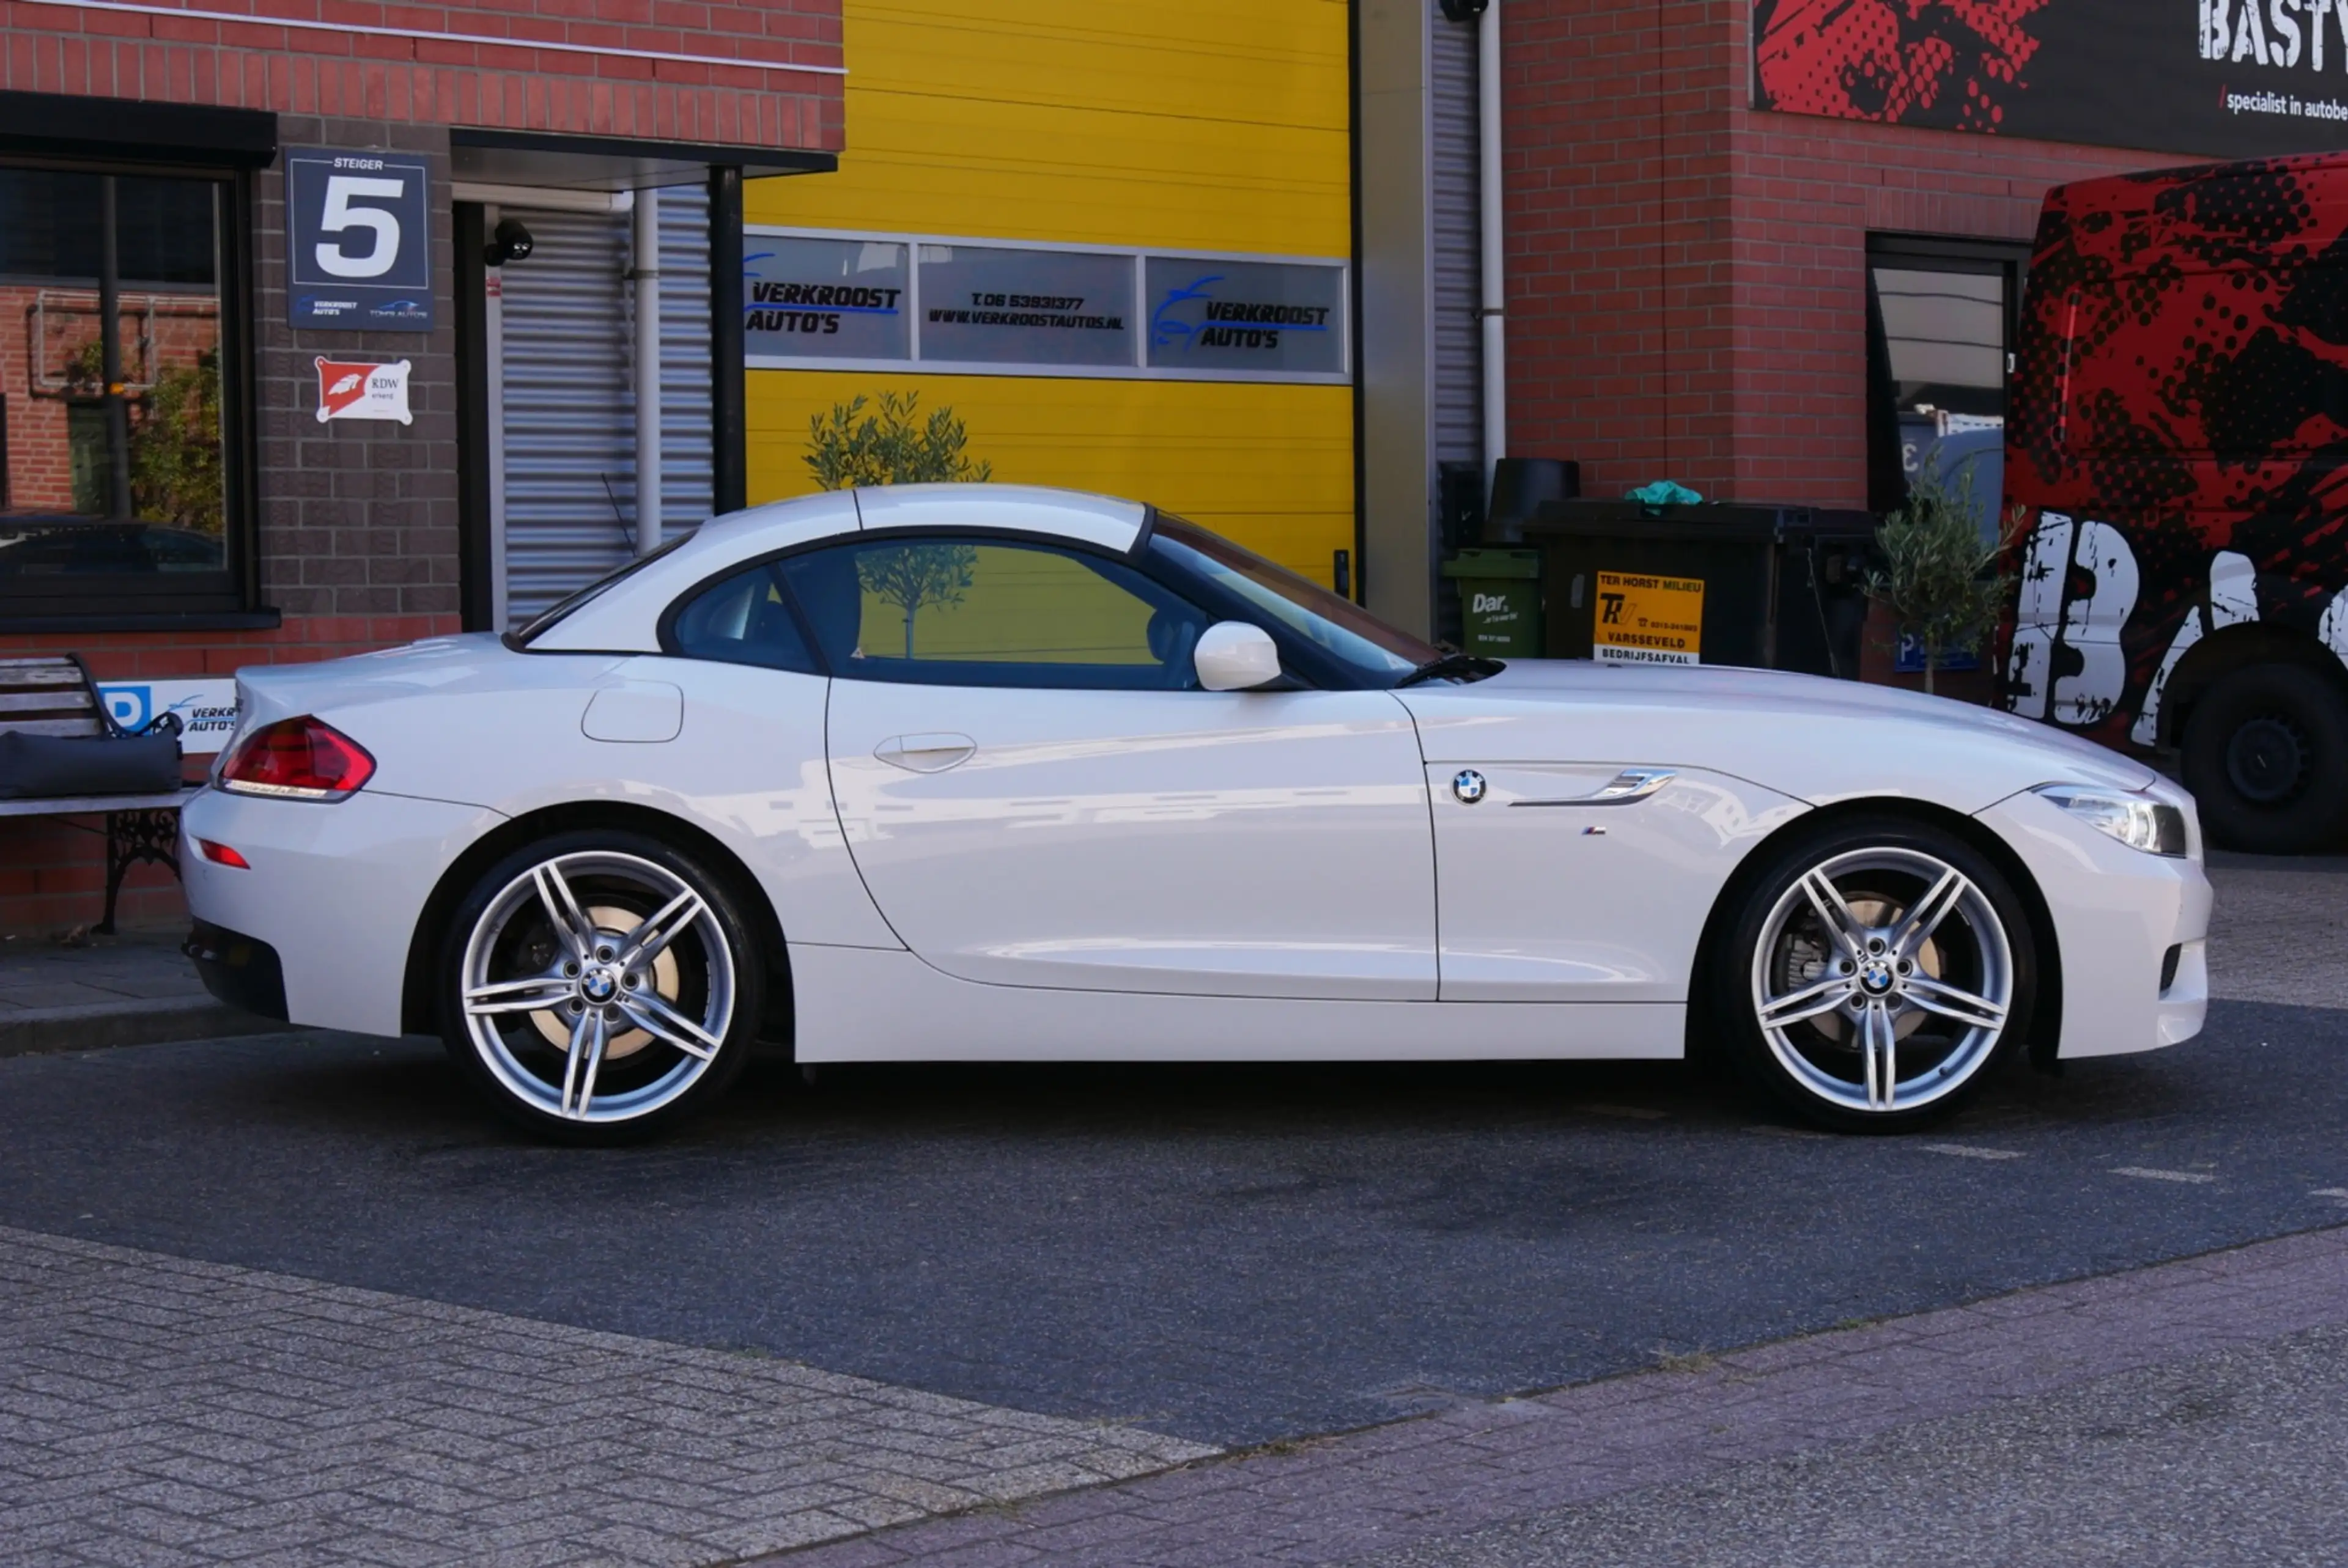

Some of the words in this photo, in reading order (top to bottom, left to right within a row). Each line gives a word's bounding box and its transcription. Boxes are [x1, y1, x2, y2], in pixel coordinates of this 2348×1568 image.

[2227, 91, 2286, 115] specialist
[2290, 95, 2302, 116] in
[334, 157, 383, 171] STEIGER
[315, 175, 404, 278] 5
[753, 282, 901, 309] VERKROOST
[745, 310, 840, 334] AUTO'S
[928, 308, 1124, 330] WWW.VERKROOSTAUTOS.NL
[1206, 301, 1330, 326] VERKROOST
[1201, 327, 1279, 349] AUTO'S
[372, 378, 399, 389] RDW
[1600, 575, 1620, 585] TER
[1623, 576, 1659, 589] HORST
[1663, 580, 1702, 593] MILIEU
[1608, 631, 1686, 649] VARSSEVELD
[1602, 649, 1690, 664] BEDRIJFSAFVAL
